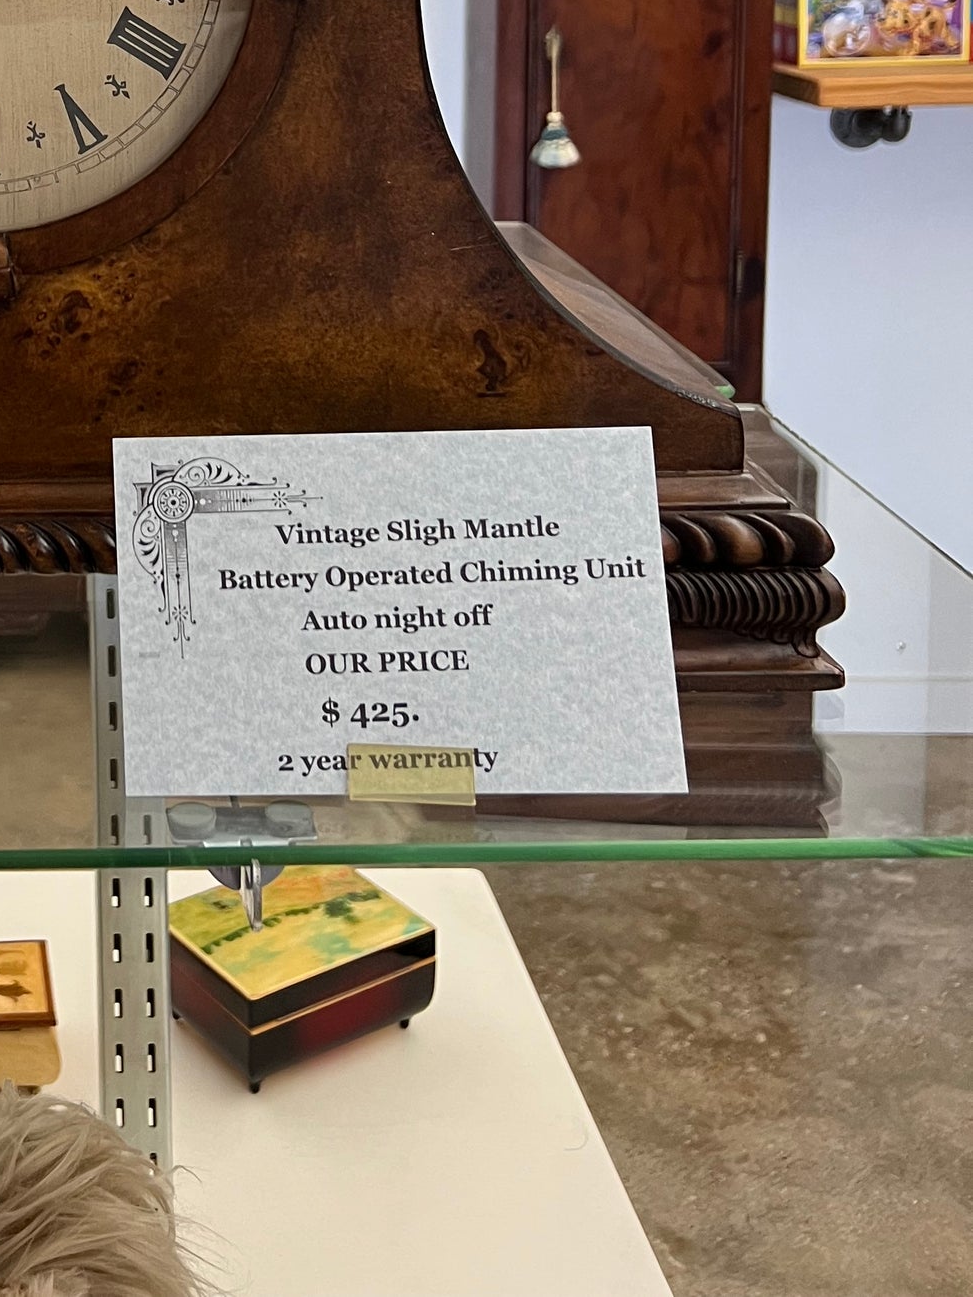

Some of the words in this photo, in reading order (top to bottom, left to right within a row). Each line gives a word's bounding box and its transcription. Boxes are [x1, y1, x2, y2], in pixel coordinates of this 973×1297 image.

[274, 522, 380, 548] Vintage
[387, 518, 456, 546] Sligh
[463, 515, 561, 540] Mantle
[218, 568, 319, 593] Battery
[325, 561, 453, 592] Operated
[460, 559, 579, 586] Chiming
[584, 556, 647, 580] Unit
[300, 610, 368, 631] Auto
[374, 605, 447, 634] night
[454, 604, 494, 627] off
[305, 652, 373, 675] OUR
[378, 649, 470, 673] PRICE
[321, 696, 341, 728] $
[350, 702, 420, 729] 425.
[278, 754, 294, 772] 2
[300, 753, 362, 778] year
[369, 747, 499, 773] warranty
